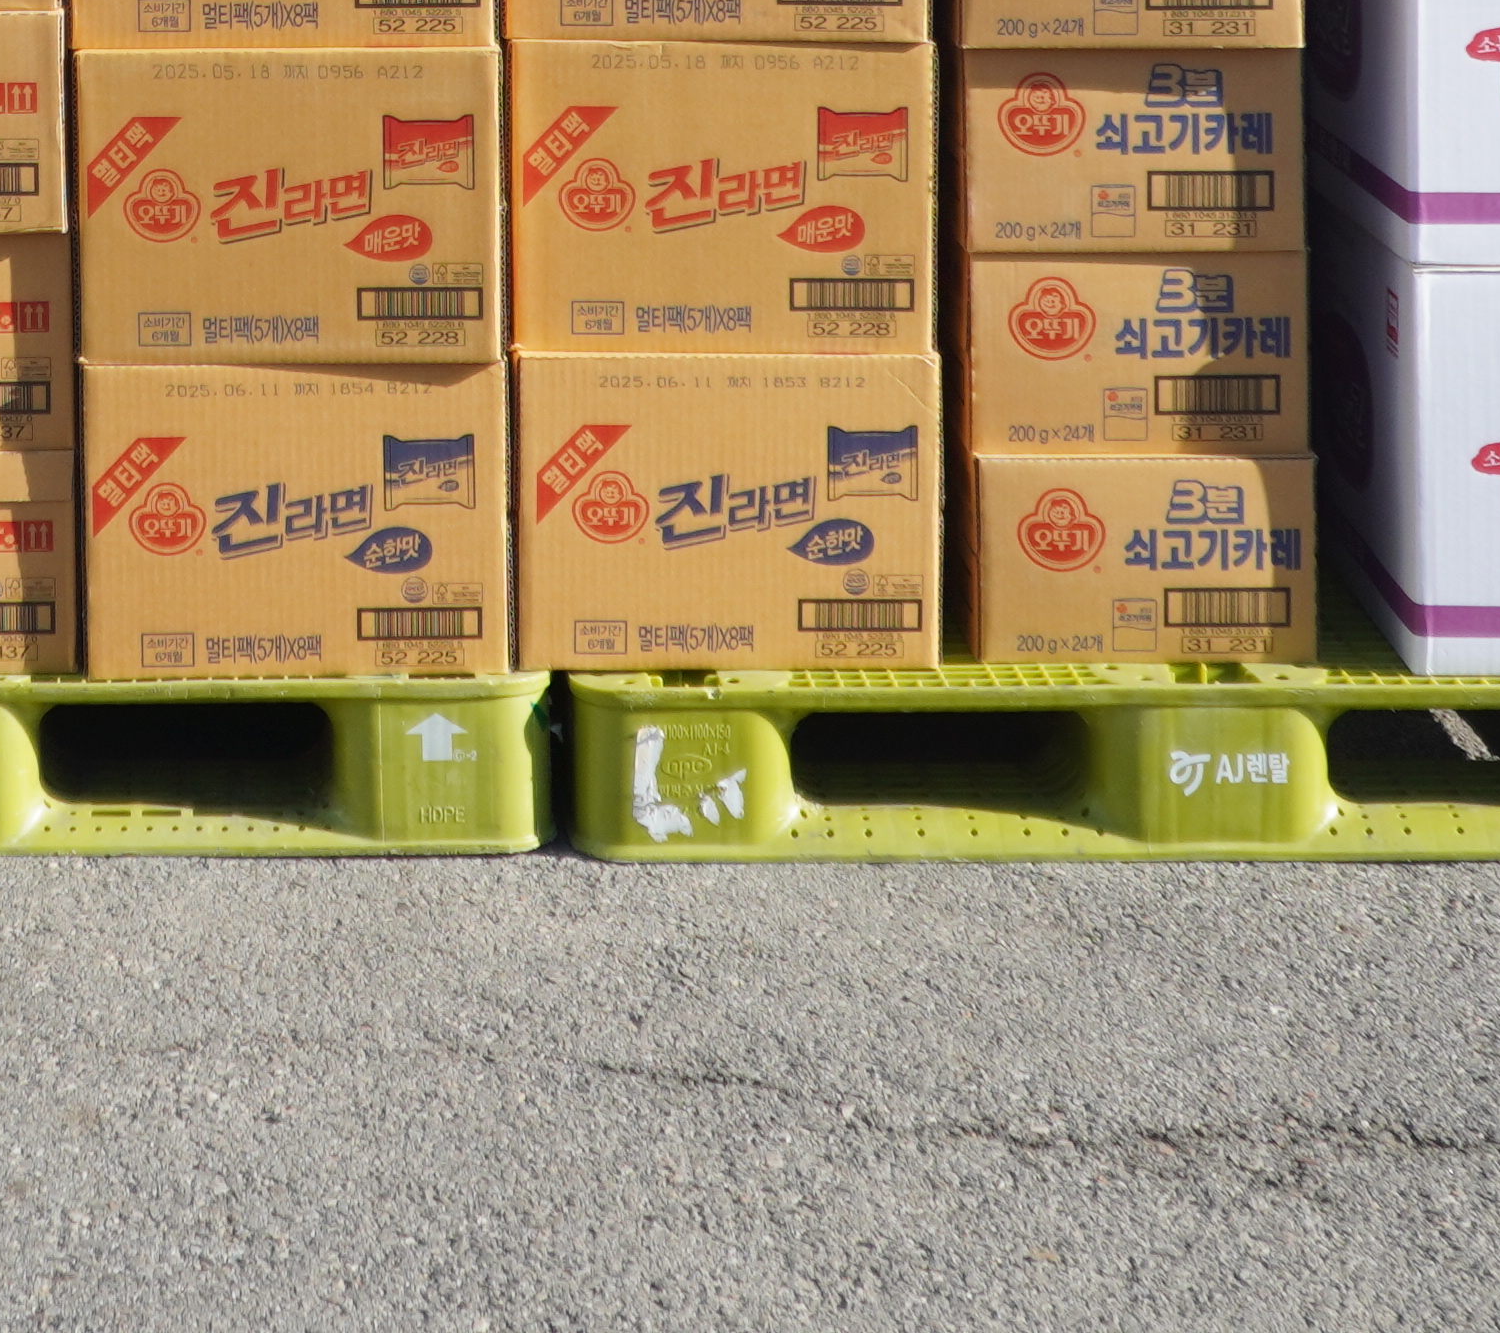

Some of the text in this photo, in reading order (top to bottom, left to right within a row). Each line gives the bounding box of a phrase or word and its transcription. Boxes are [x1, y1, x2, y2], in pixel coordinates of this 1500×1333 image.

[284, 64, 309, 80] 까지
[318, 65, 364, 80] 0956
[378, 64, 423, 79] A212
[1144, 63, 1224, 108] 3분
[1096, 112, 1274, 155] 쇠고기카레
[210, 167, 373, 243] 진라면
[645, 156, 807, 232] 진라면
[363, 219, 422, 254] 매운맛
[796, 212, 855, 245] 매운맛
[1156, 268, 1234, 313] 3분
[379, 331, 459, 344] 52 228
[1115, 316, 1290, 359] 쇠고기카레
[653, 475, 818, 552] 진라면
[1166, 480, 1245, 524] 3분
[804, 527, 864, 559] 순한맛
[1124, 528, 1301, 571] 쇠고기카레
[1216, 753, 1290, 784] AJ렌탈
